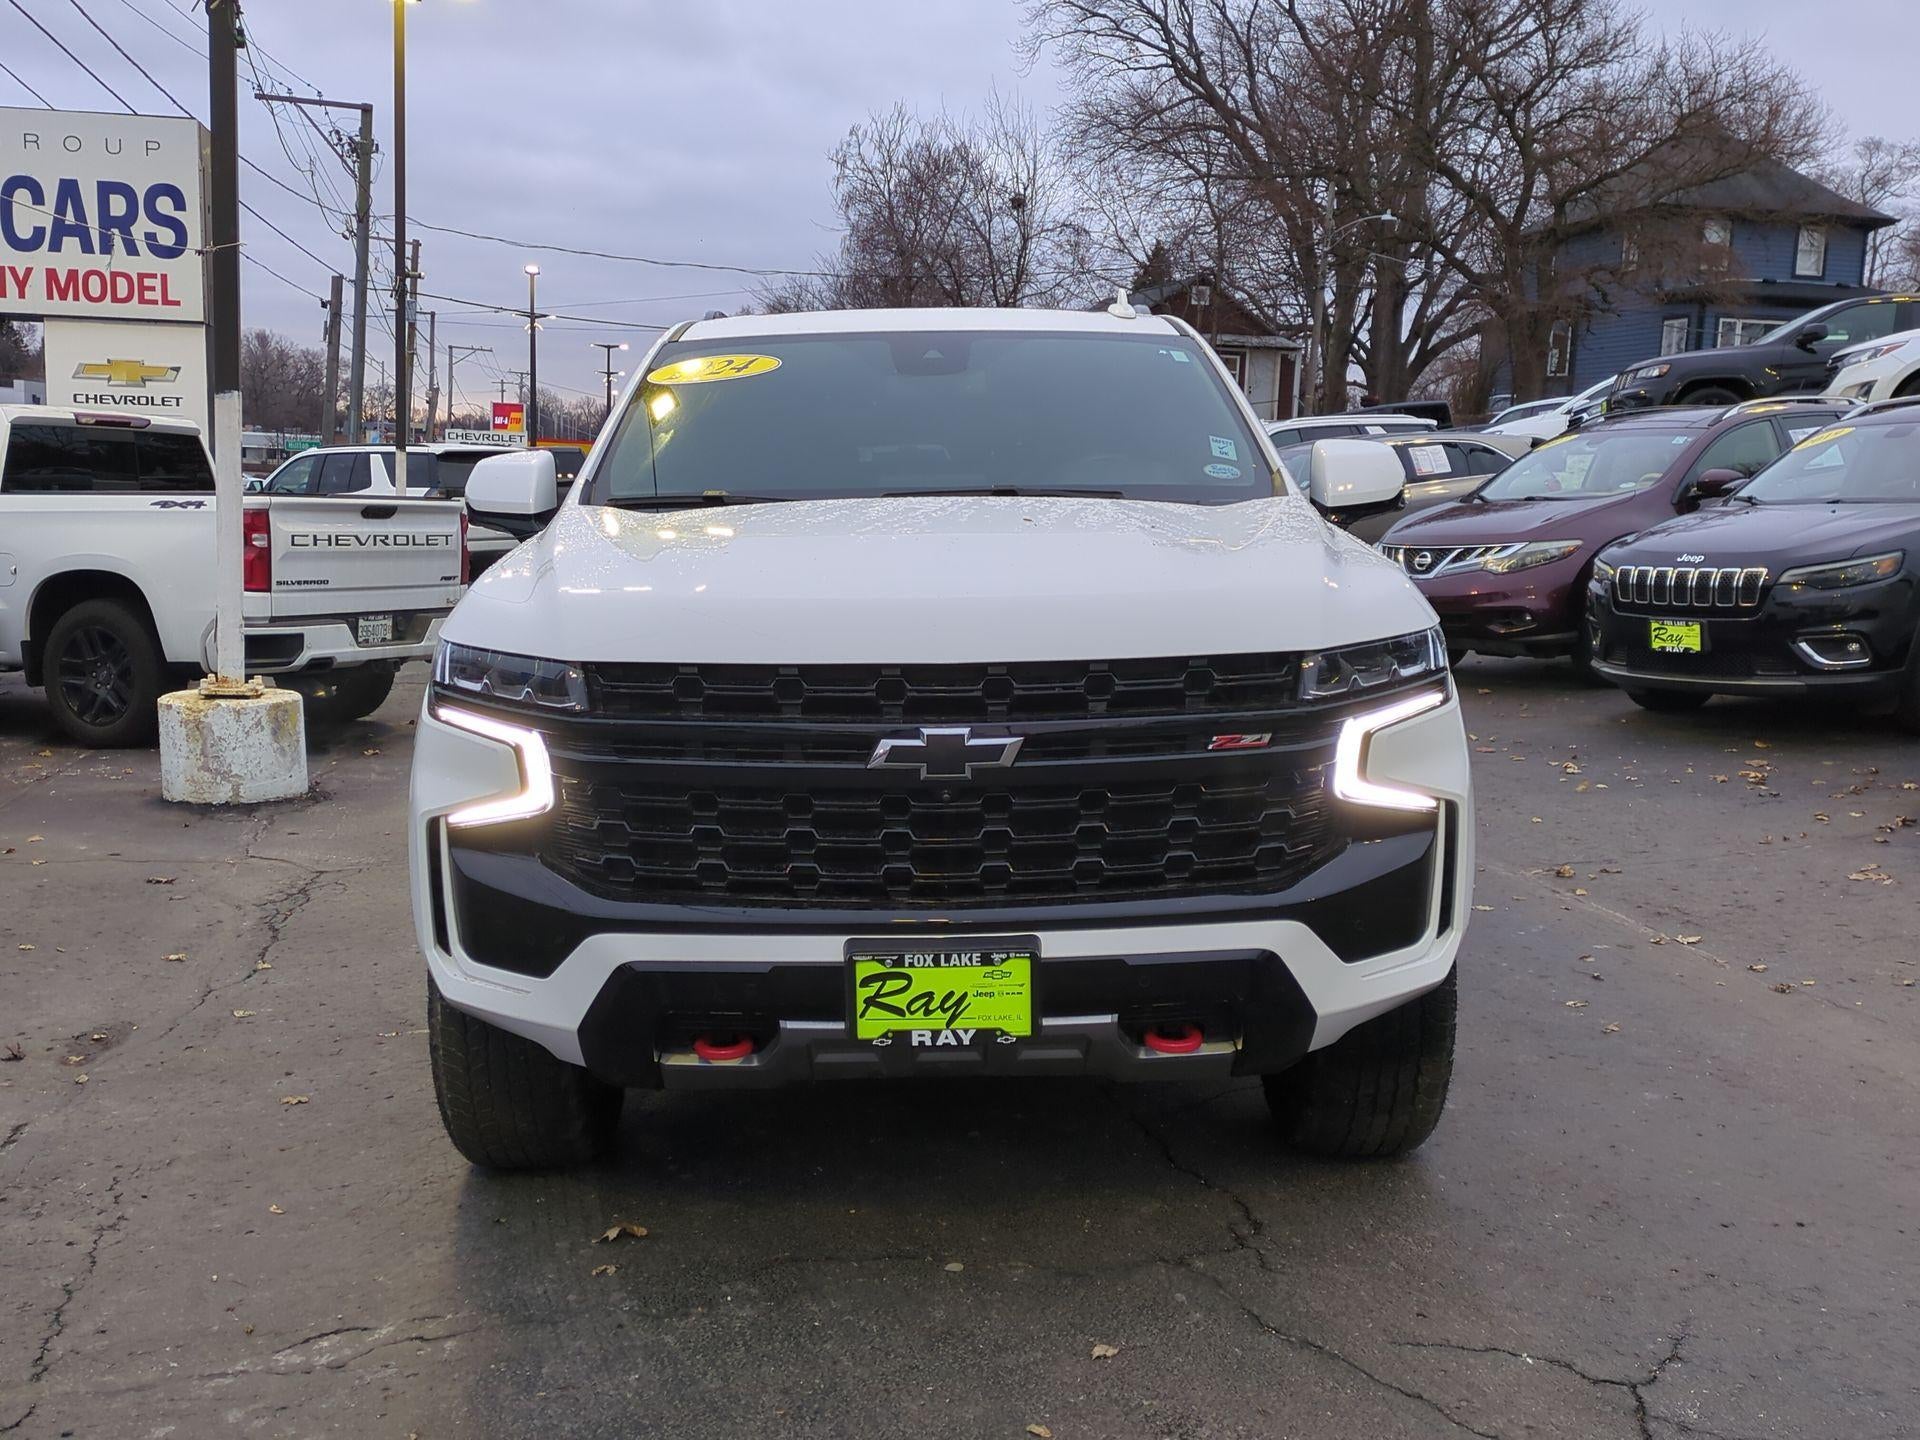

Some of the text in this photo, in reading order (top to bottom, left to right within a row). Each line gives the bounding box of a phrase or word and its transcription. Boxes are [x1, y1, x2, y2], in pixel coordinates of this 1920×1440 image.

[0, 174, 189, 260] CARS
[0, 265, 181, 307] Y MODEL
[72, 392, 184, 408] CHEVROLET
[447, 431, 526, 444] CHEVROLET
[290, 533, 454, 548] CHEVROLET
[1677, 553, 1705, 563] Jeep
[275, 579, 330, 587] SILVERADO
[1652, 626, 1685, 647] Ray
[1207, 733, 1272, 750] Z71
[904, 954, 935, 968] FOX
[940, 953, 982, 967] LAKE
[858, 971, 972, 1029] Ray
[972, 989, 996, 998] Jeep
[911, 1029, 977, 1046] RAY
